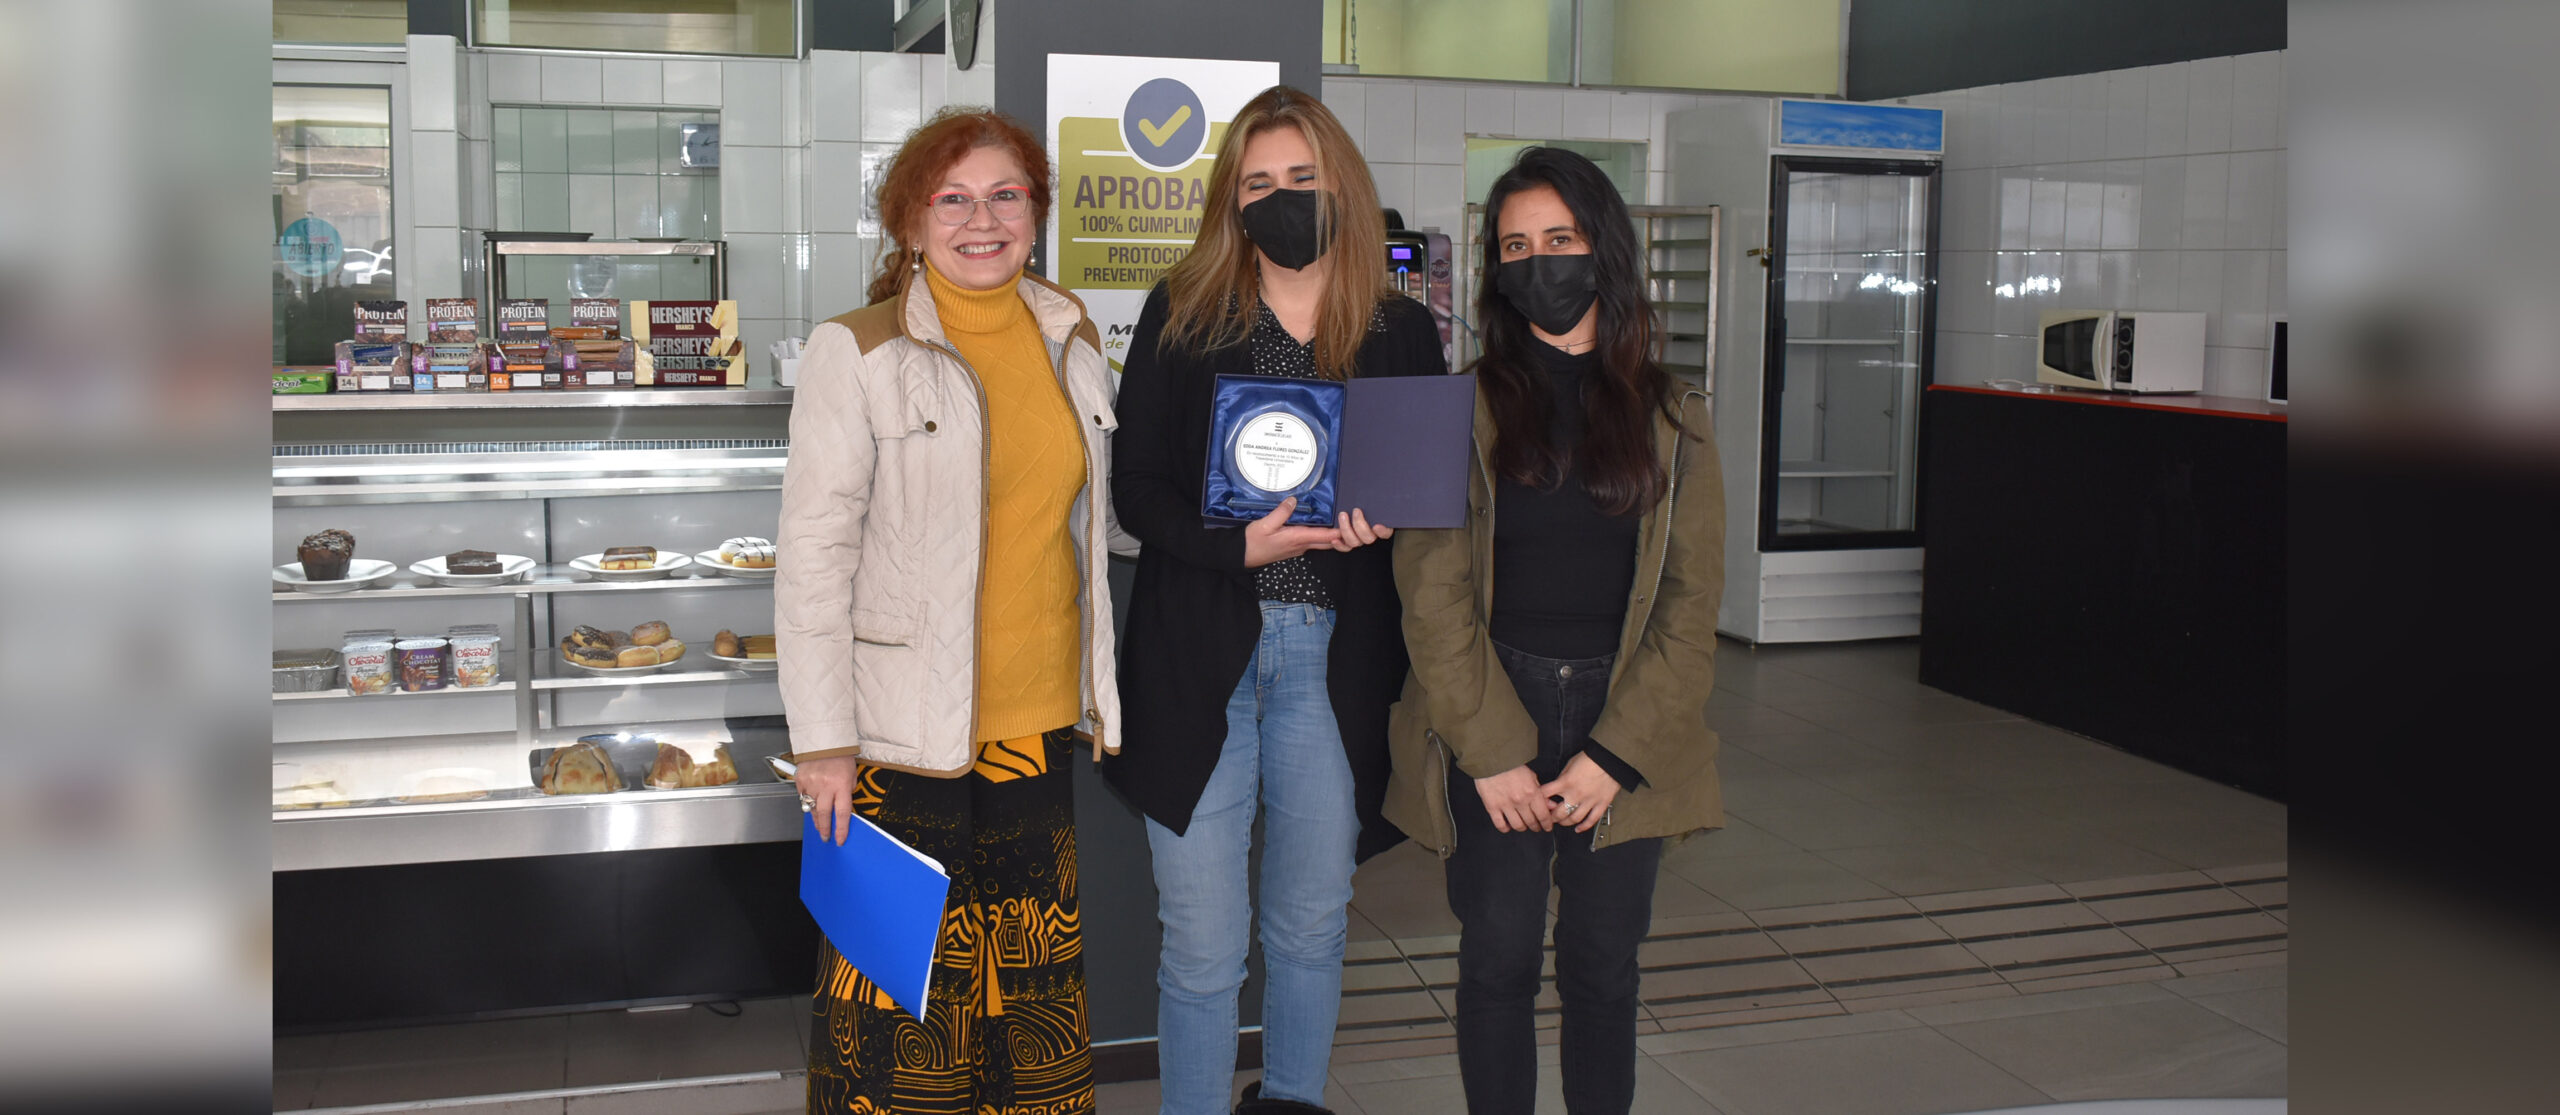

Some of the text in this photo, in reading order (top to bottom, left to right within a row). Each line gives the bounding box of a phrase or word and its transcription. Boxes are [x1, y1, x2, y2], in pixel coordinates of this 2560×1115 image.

[1073, 175, 1207, 211] APROBA
[1080, 215, 1200, 234] 100% CUMPLIM
[1108, 246, 1189, 265] PROTOCO
[357, 307, 405, 320] PROTEIN
[429, 305, 475, 319] PROTEIN
[501, 306, 546, 320] PROTEIN
[573, 305, 617, 319] PROTEIN
[651, 306, 713, 324] HERSHEY'S
[664, 372, 697, 382] HERSHEY'S
